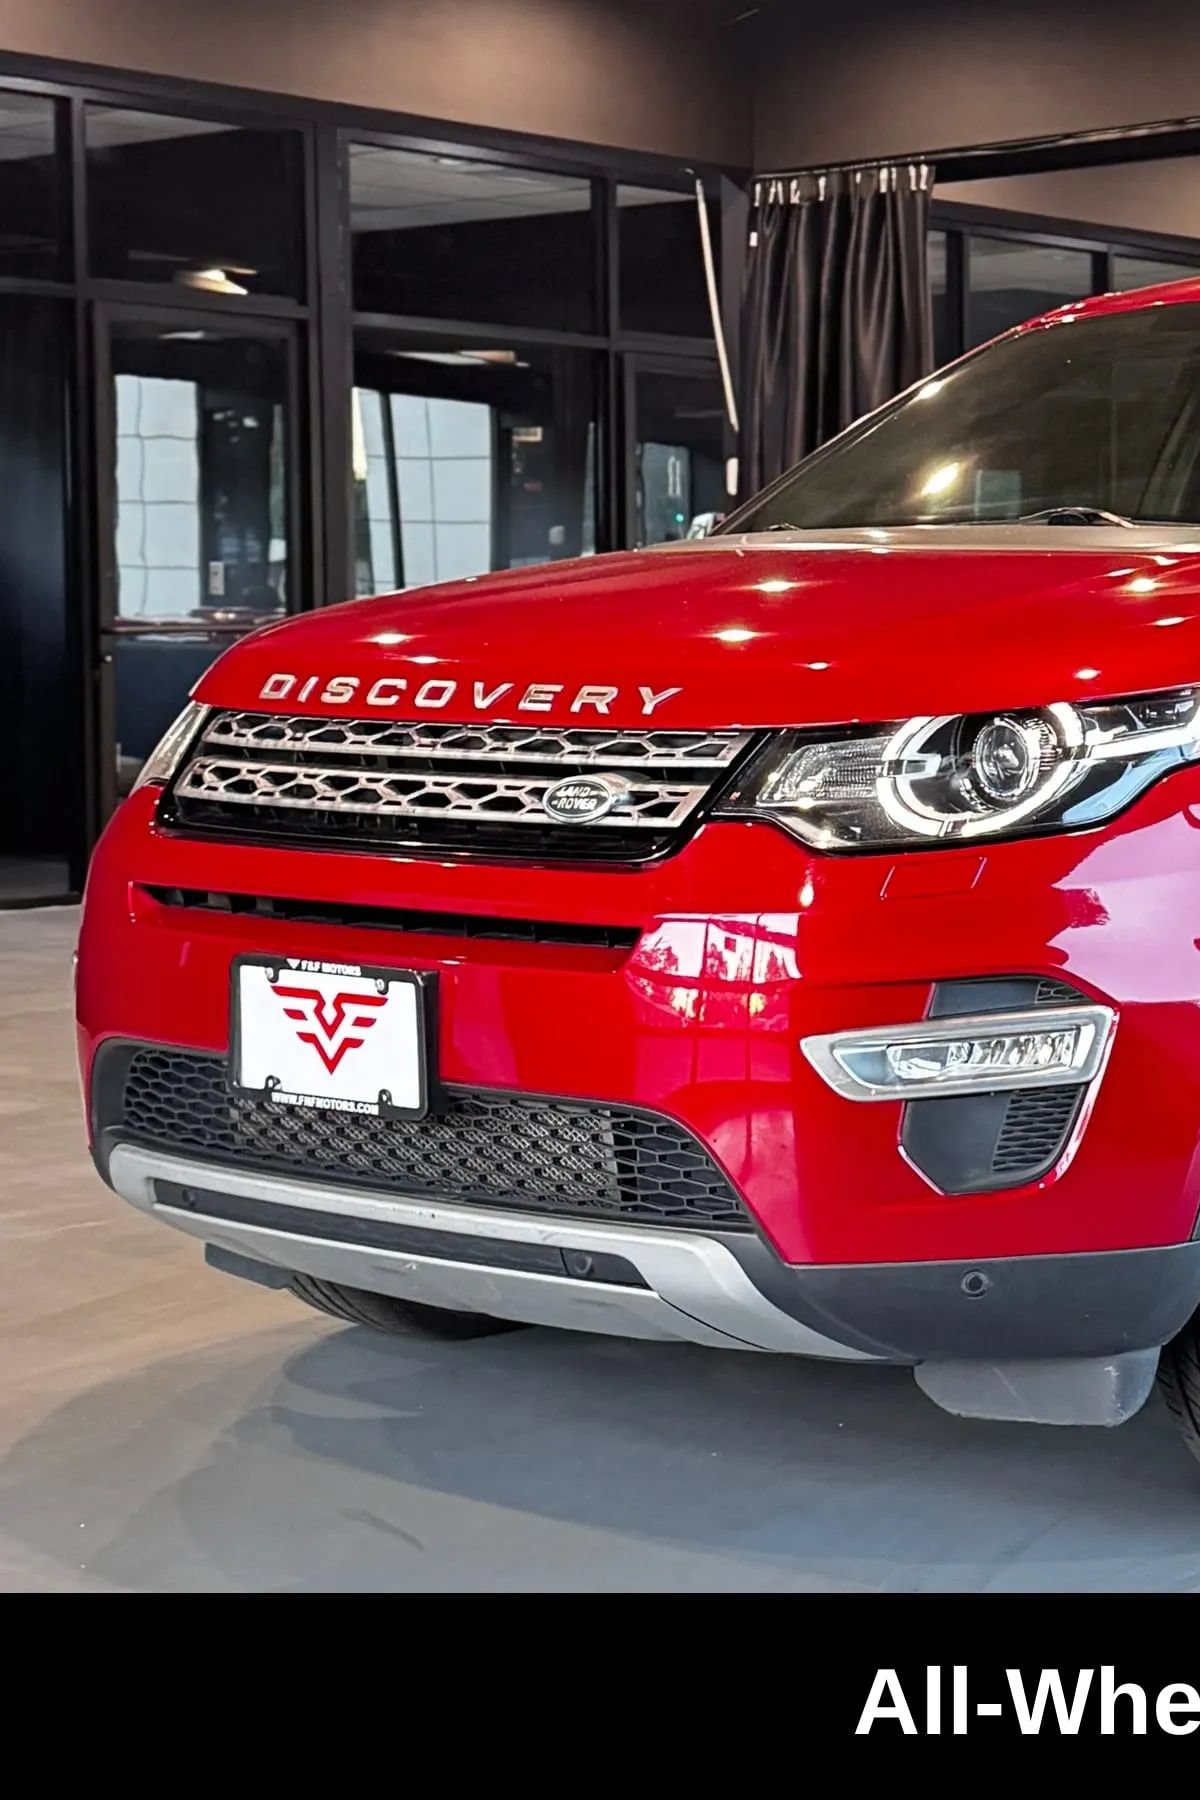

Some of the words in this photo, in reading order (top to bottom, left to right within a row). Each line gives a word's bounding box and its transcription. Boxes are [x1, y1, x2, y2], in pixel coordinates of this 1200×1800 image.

[258, 673, 683, 716] DISCOVERY
[556, 786, 591, 797] LAND
[557, 798, 598, 811] ROVER
[321, 962, 361, 976] MOTORS
